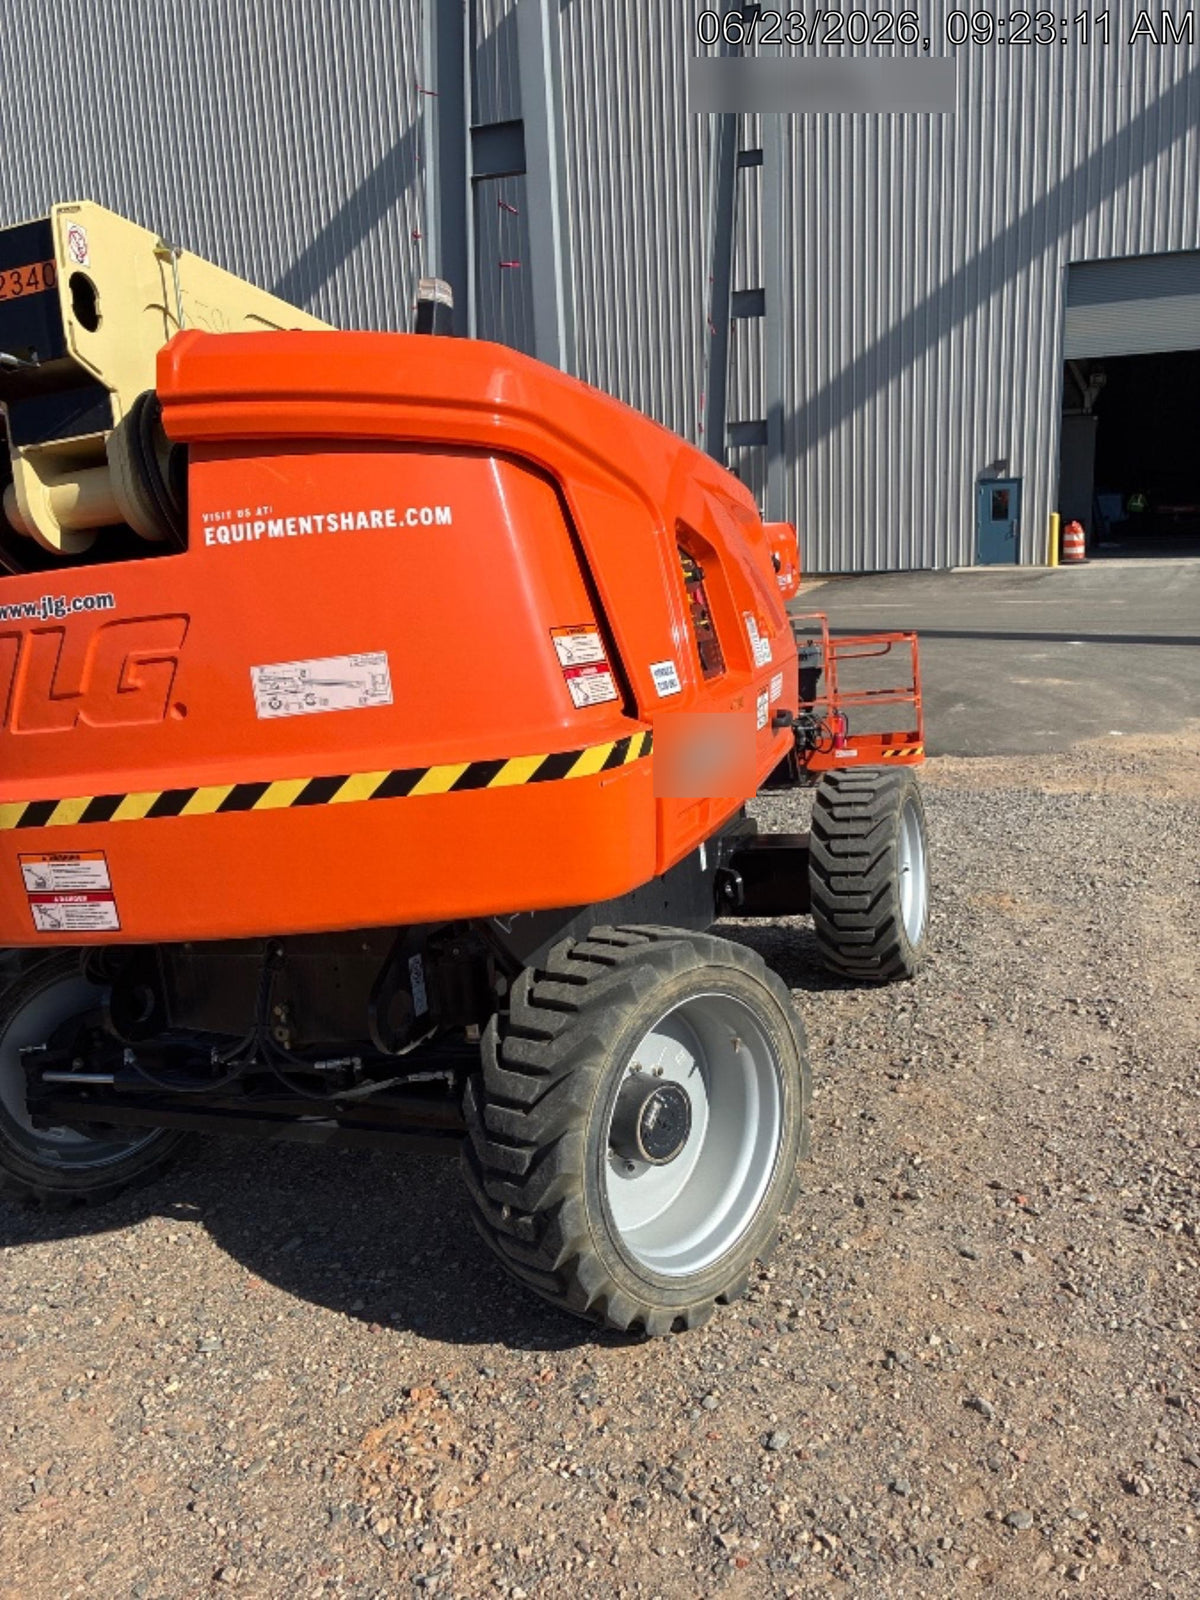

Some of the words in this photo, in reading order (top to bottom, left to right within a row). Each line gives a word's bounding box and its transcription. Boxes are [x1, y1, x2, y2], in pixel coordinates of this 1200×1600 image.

[202, 510, 232, 522] VISIT
[237, 508, 252, 518] US
[204, 506, 453, 546] EQUIPMENTSHARE.COM
